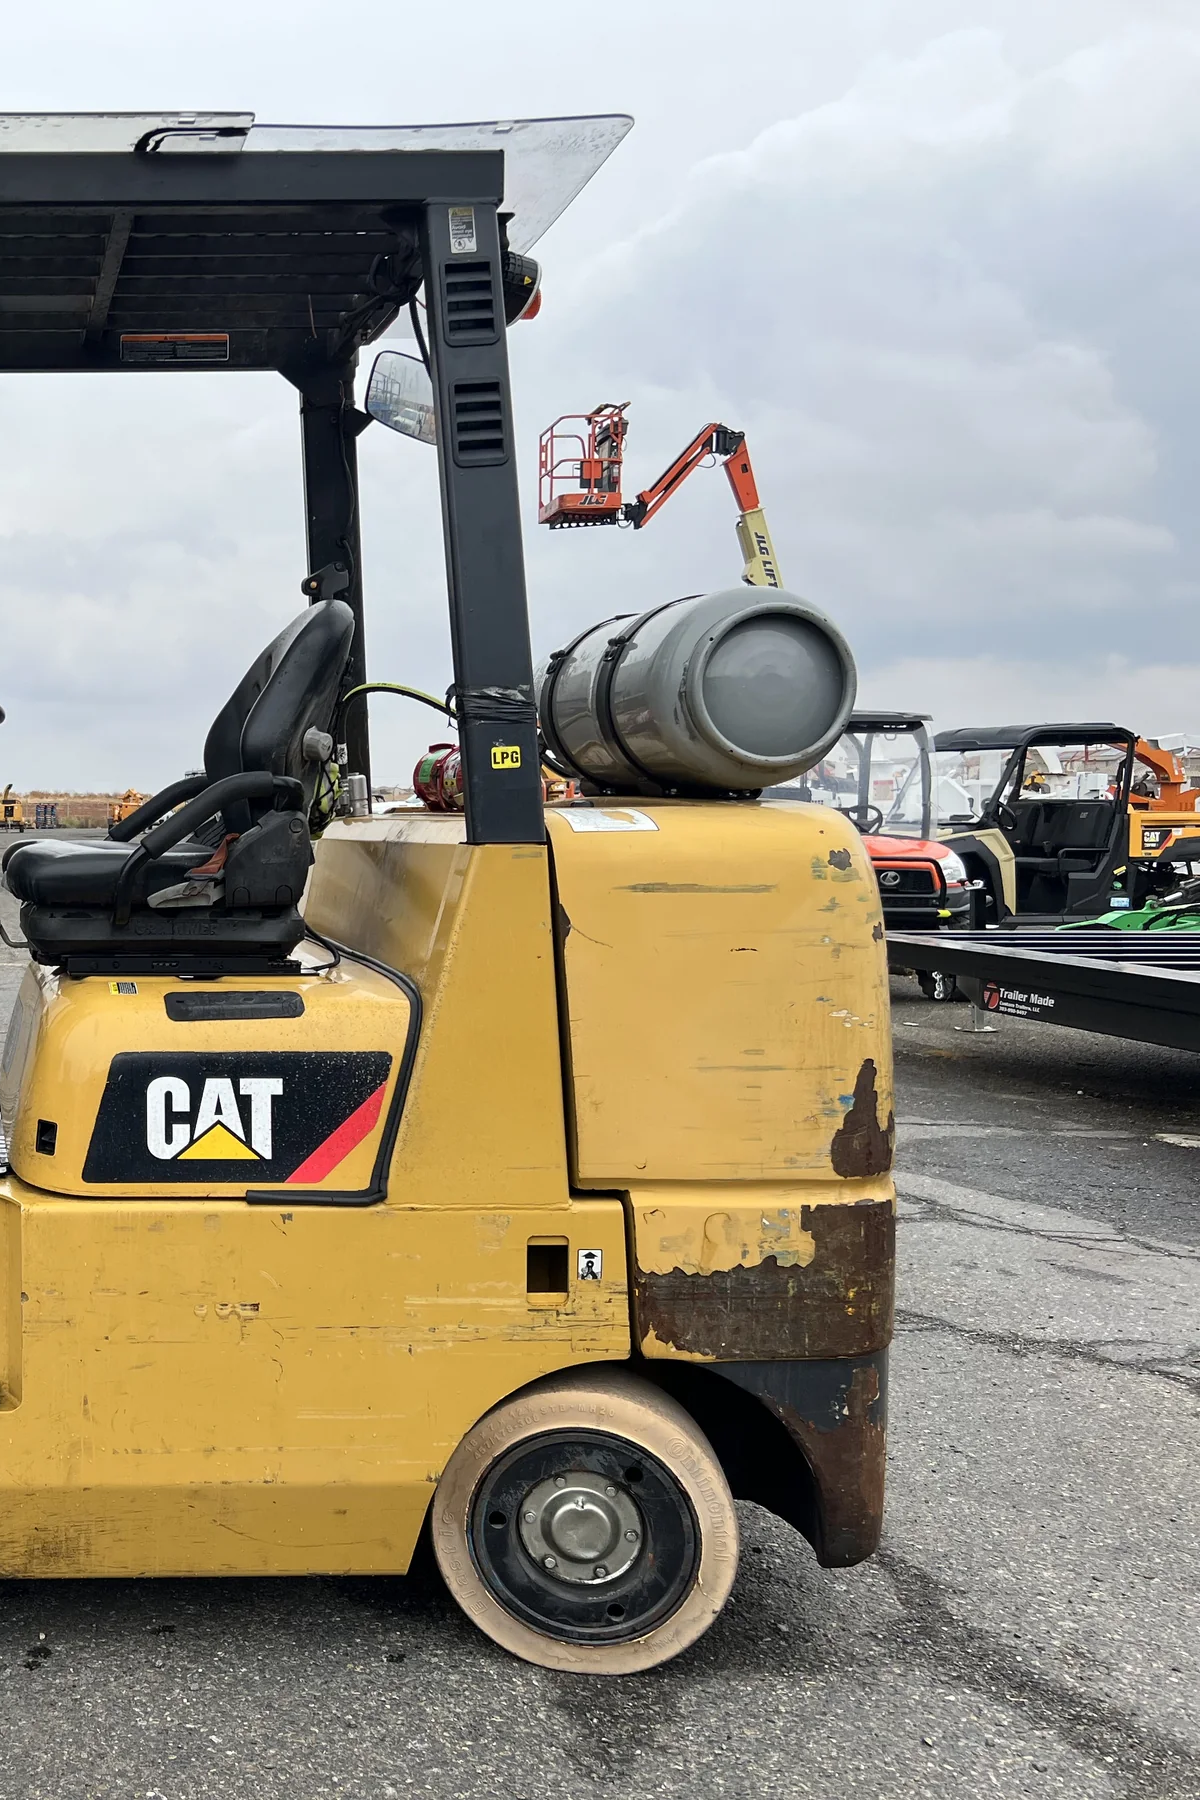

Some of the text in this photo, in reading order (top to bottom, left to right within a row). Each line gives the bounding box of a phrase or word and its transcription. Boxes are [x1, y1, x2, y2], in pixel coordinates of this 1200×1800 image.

[578, 494, 608, 506] JLG
[754, 531, 779, 589] JLG LIFT
[493, 750, 519, 765] LPG
[1143, 831, 1161, 843] CAT
[999, 987, 1056, 1007] Trailer Made
[146, 1076, 284, 1160] CAT
[438, 1507, 488, 1616] Elastic
